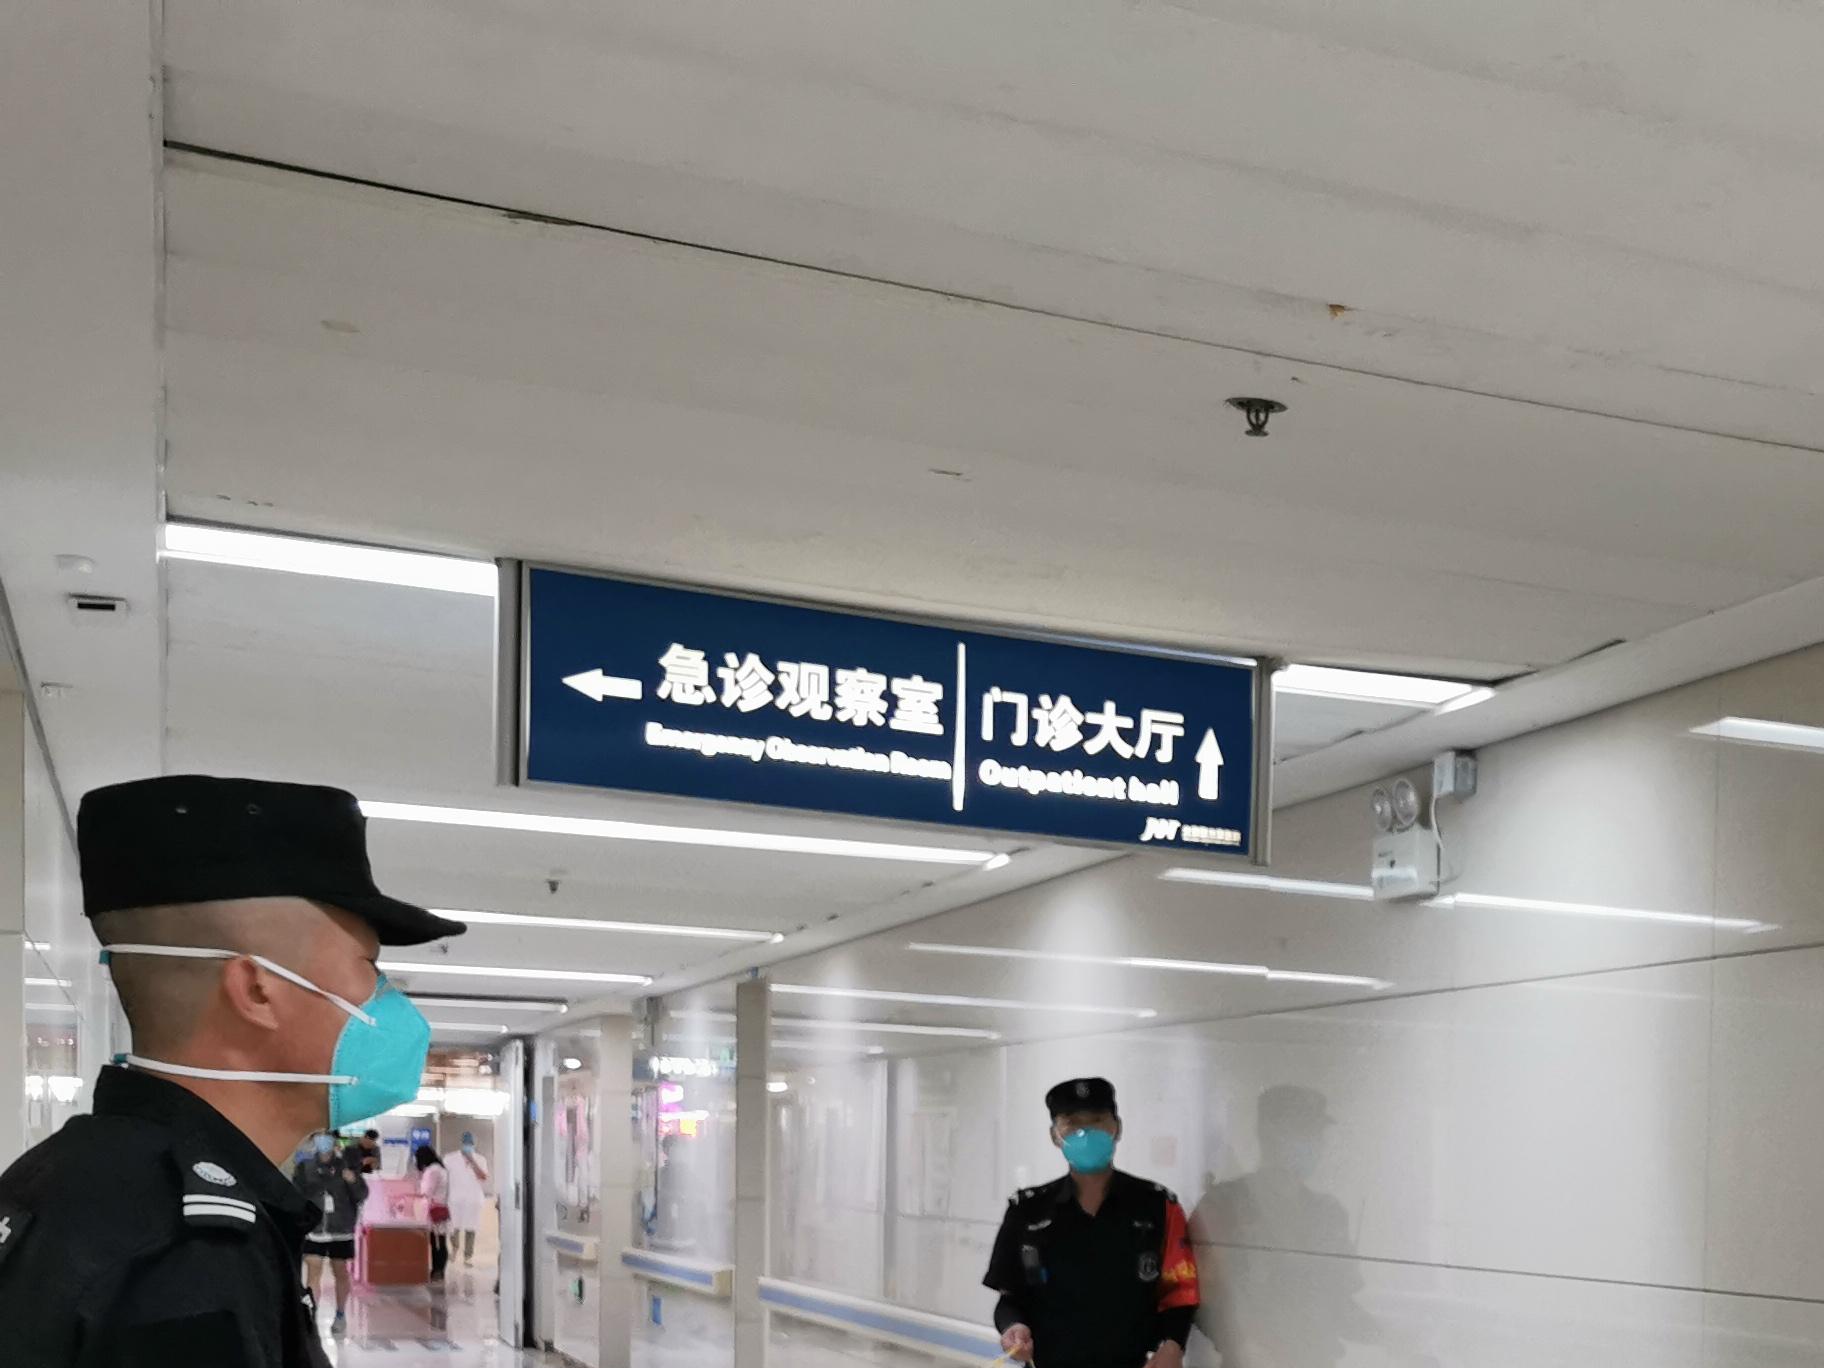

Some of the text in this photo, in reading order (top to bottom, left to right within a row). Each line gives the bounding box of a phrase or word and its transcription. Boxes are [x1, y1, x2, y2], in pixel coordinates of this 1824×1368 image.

[656, 642, 945, 736] 急诊观察室
[980, 686, 1185, 763] 门诊大厅
